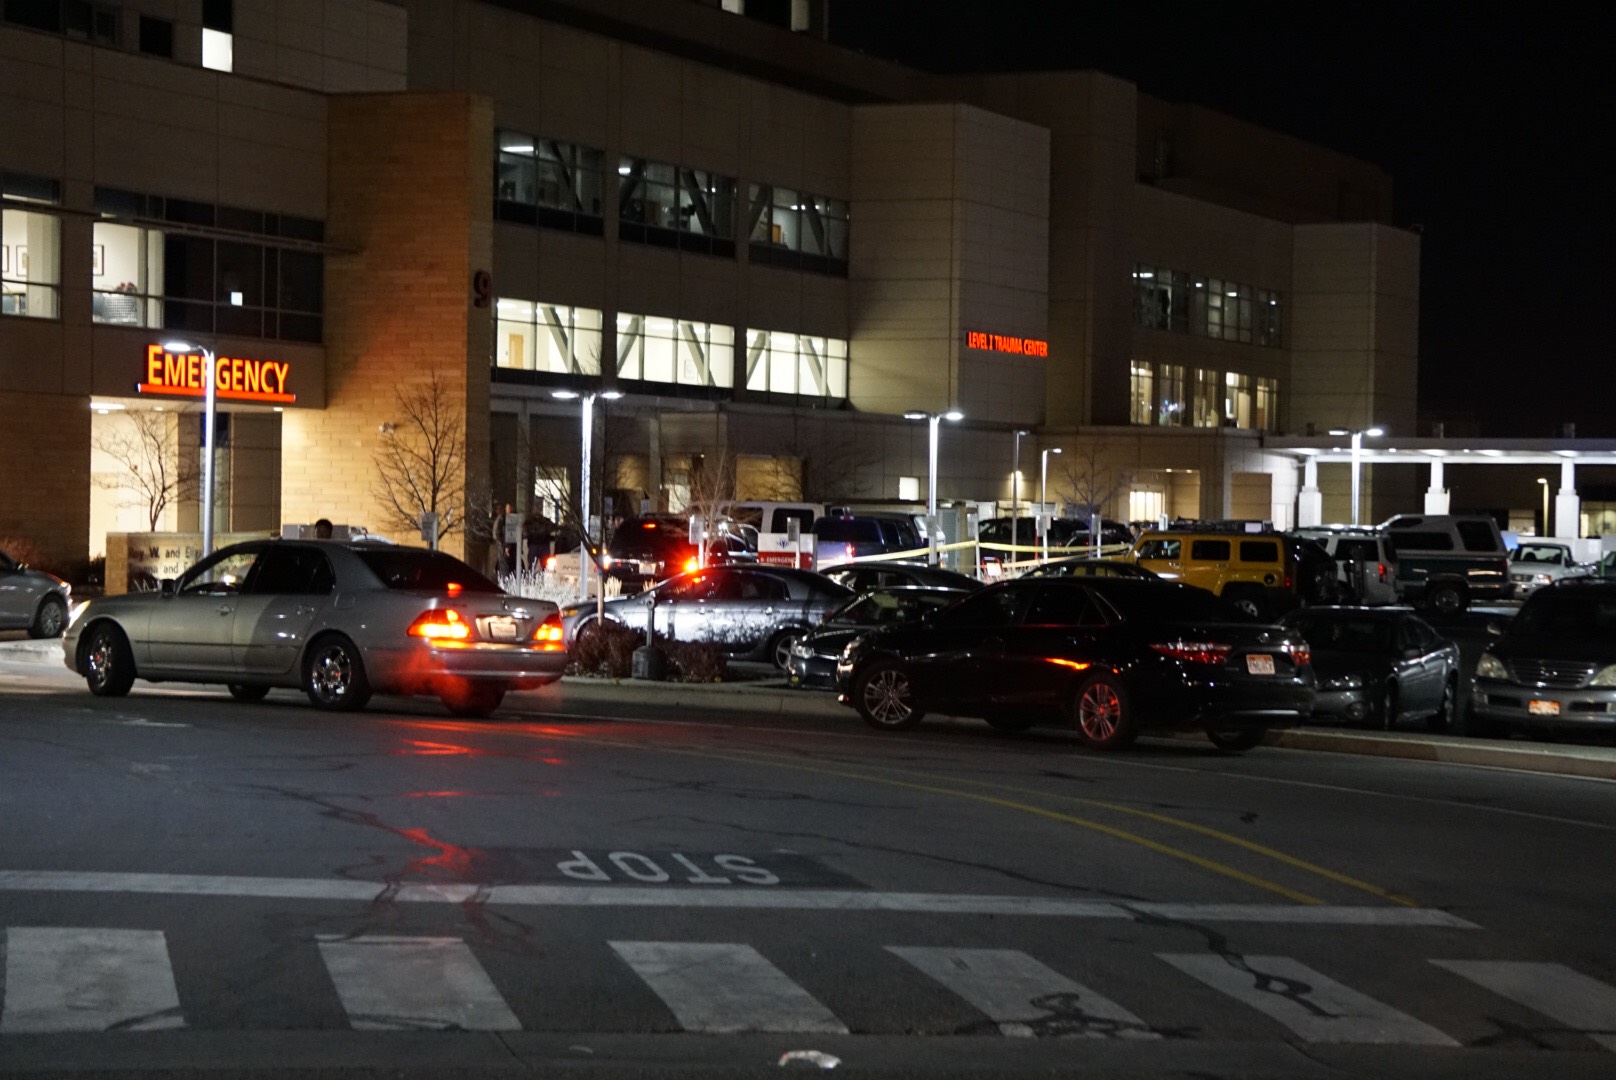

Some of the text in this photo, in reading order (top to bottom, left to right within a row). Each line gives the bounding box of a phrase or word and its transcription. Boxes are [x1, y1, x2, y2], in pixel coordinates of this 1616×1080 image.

[968, 331, 988, 350] LEVEL
[994, 335, 1023, 354] TRAUMA
[1023, 338, 1048, 357] CENTER
[165, 547, 180, 558] and
[163, 563, 178, 574] and
[556, 850, 780, 885] STOP
